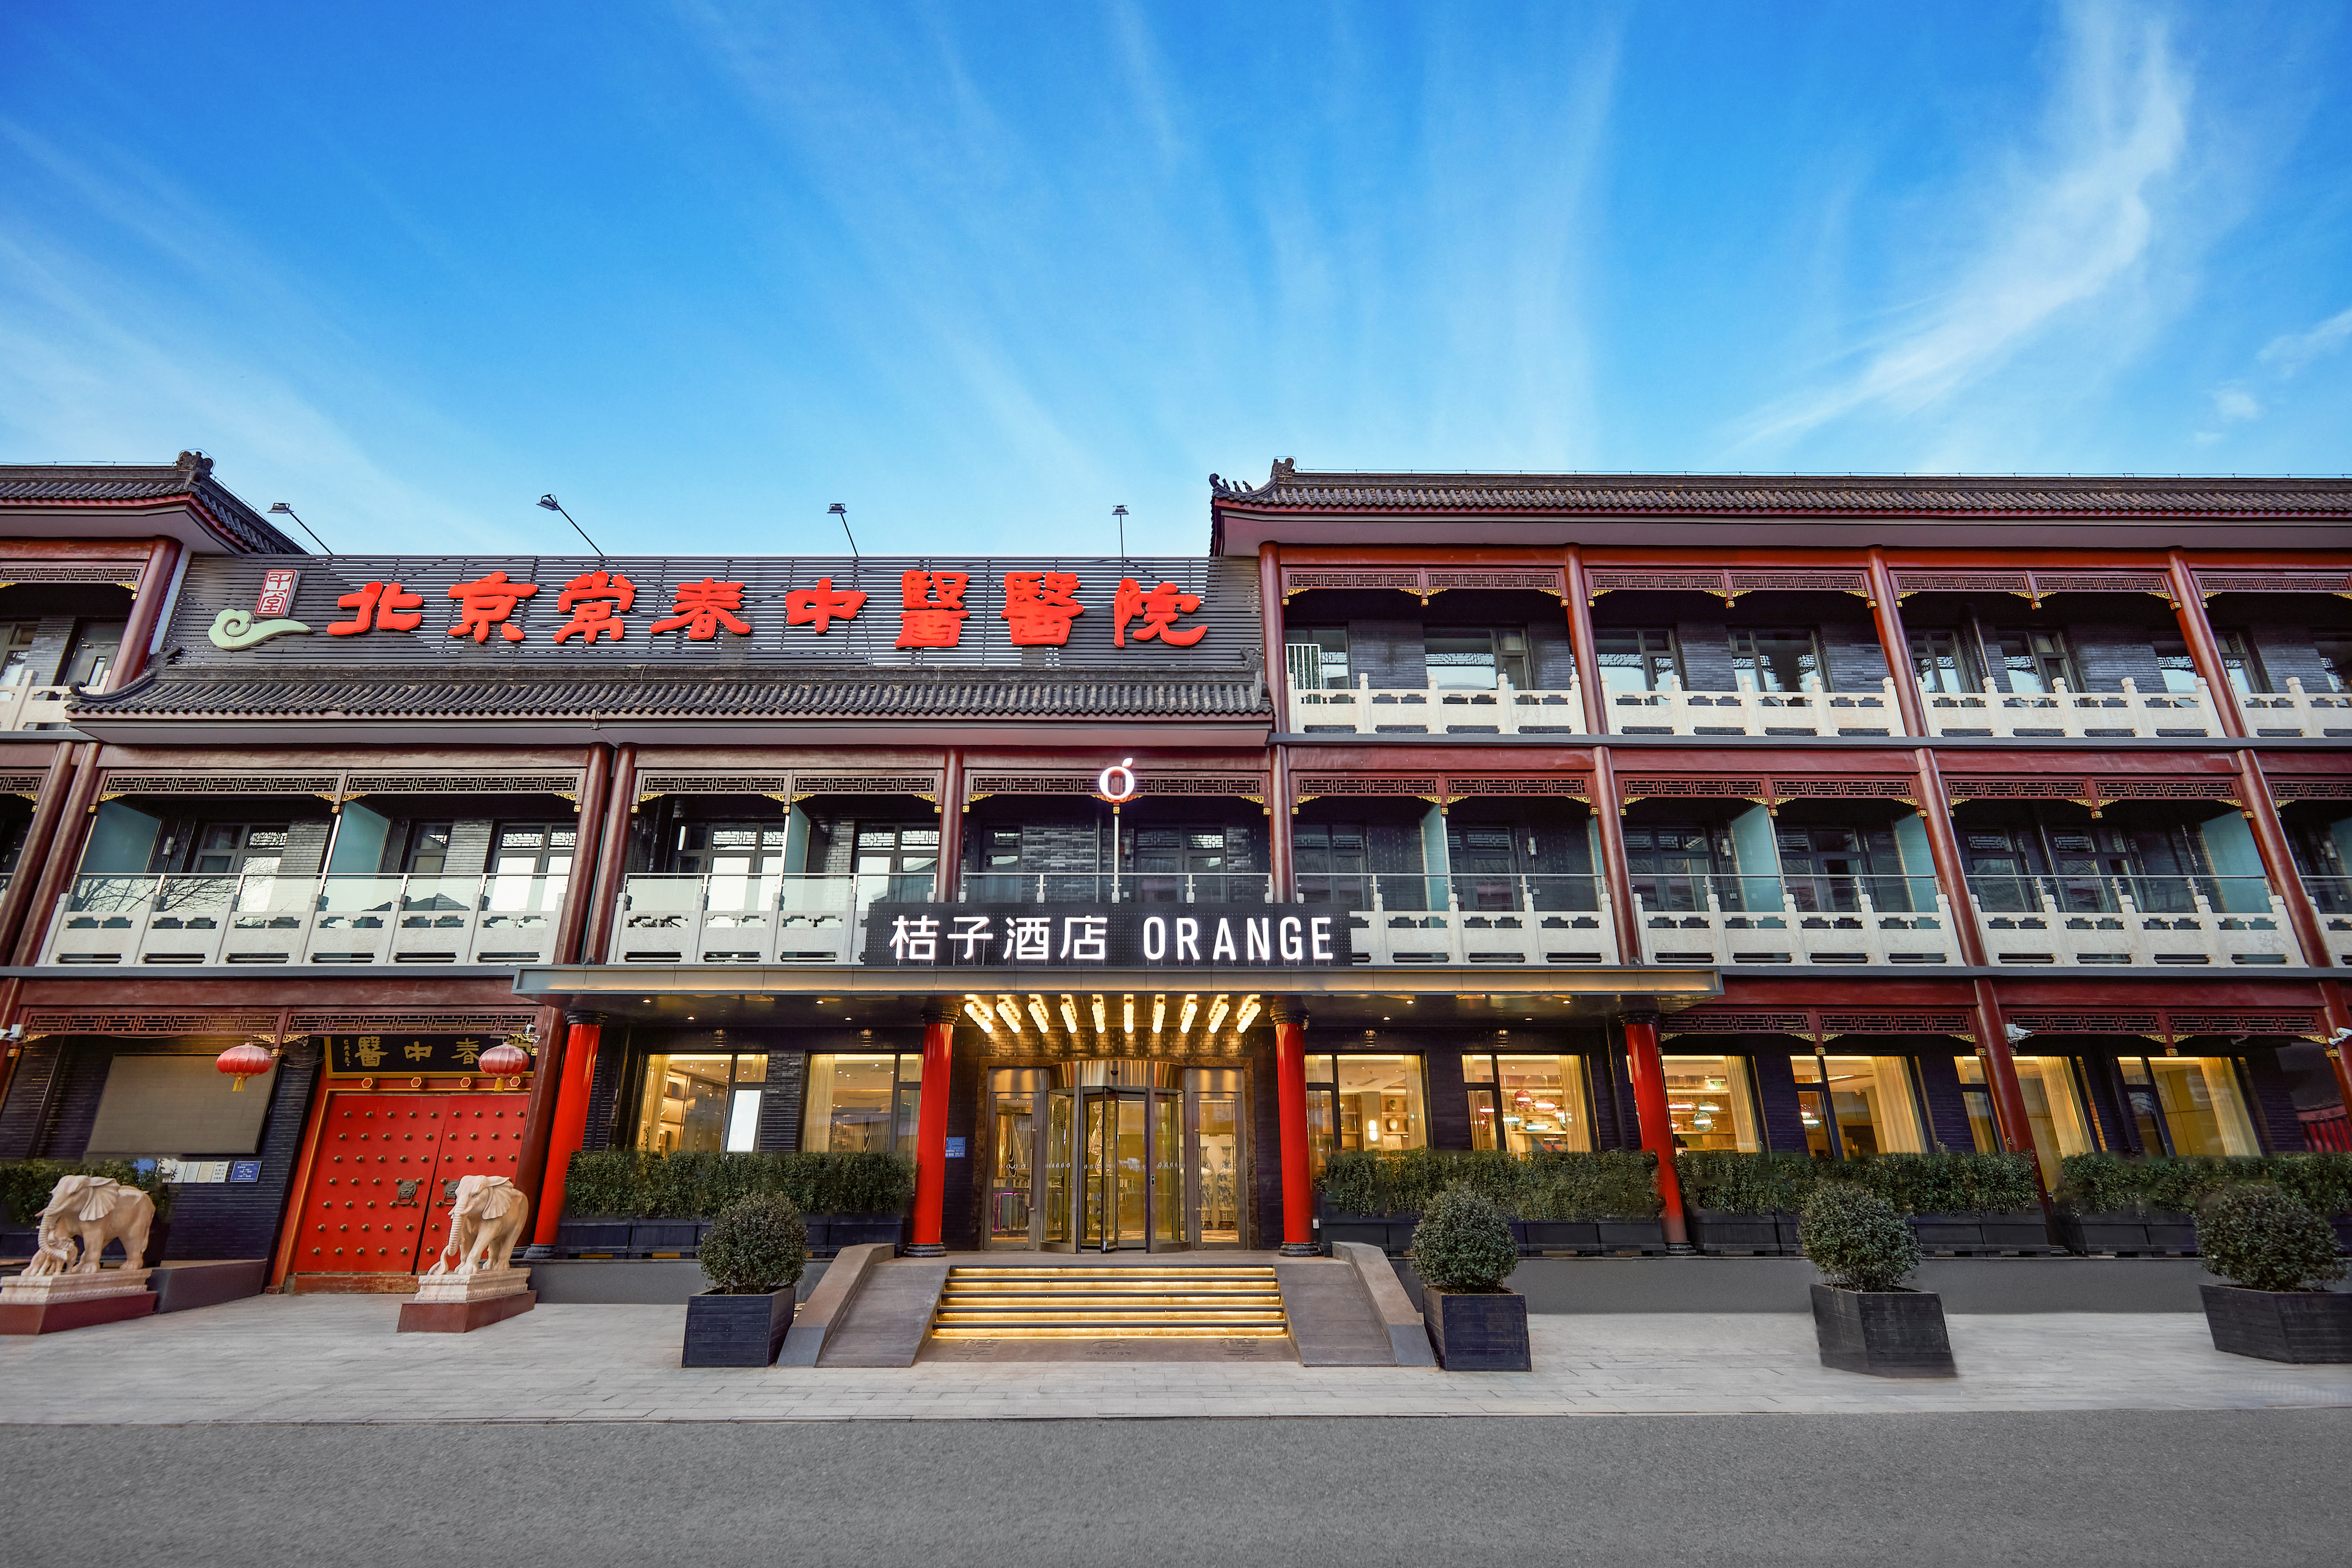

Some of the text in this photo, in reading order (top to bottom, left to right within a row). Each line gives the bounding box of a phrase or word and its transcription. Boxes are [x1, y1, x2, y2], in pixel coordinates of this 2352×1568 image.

[326, 569, 1209, 648] 北京常春中醫醫院
[888, 914, 1334, 961] 桔子酒店 ORANGE
